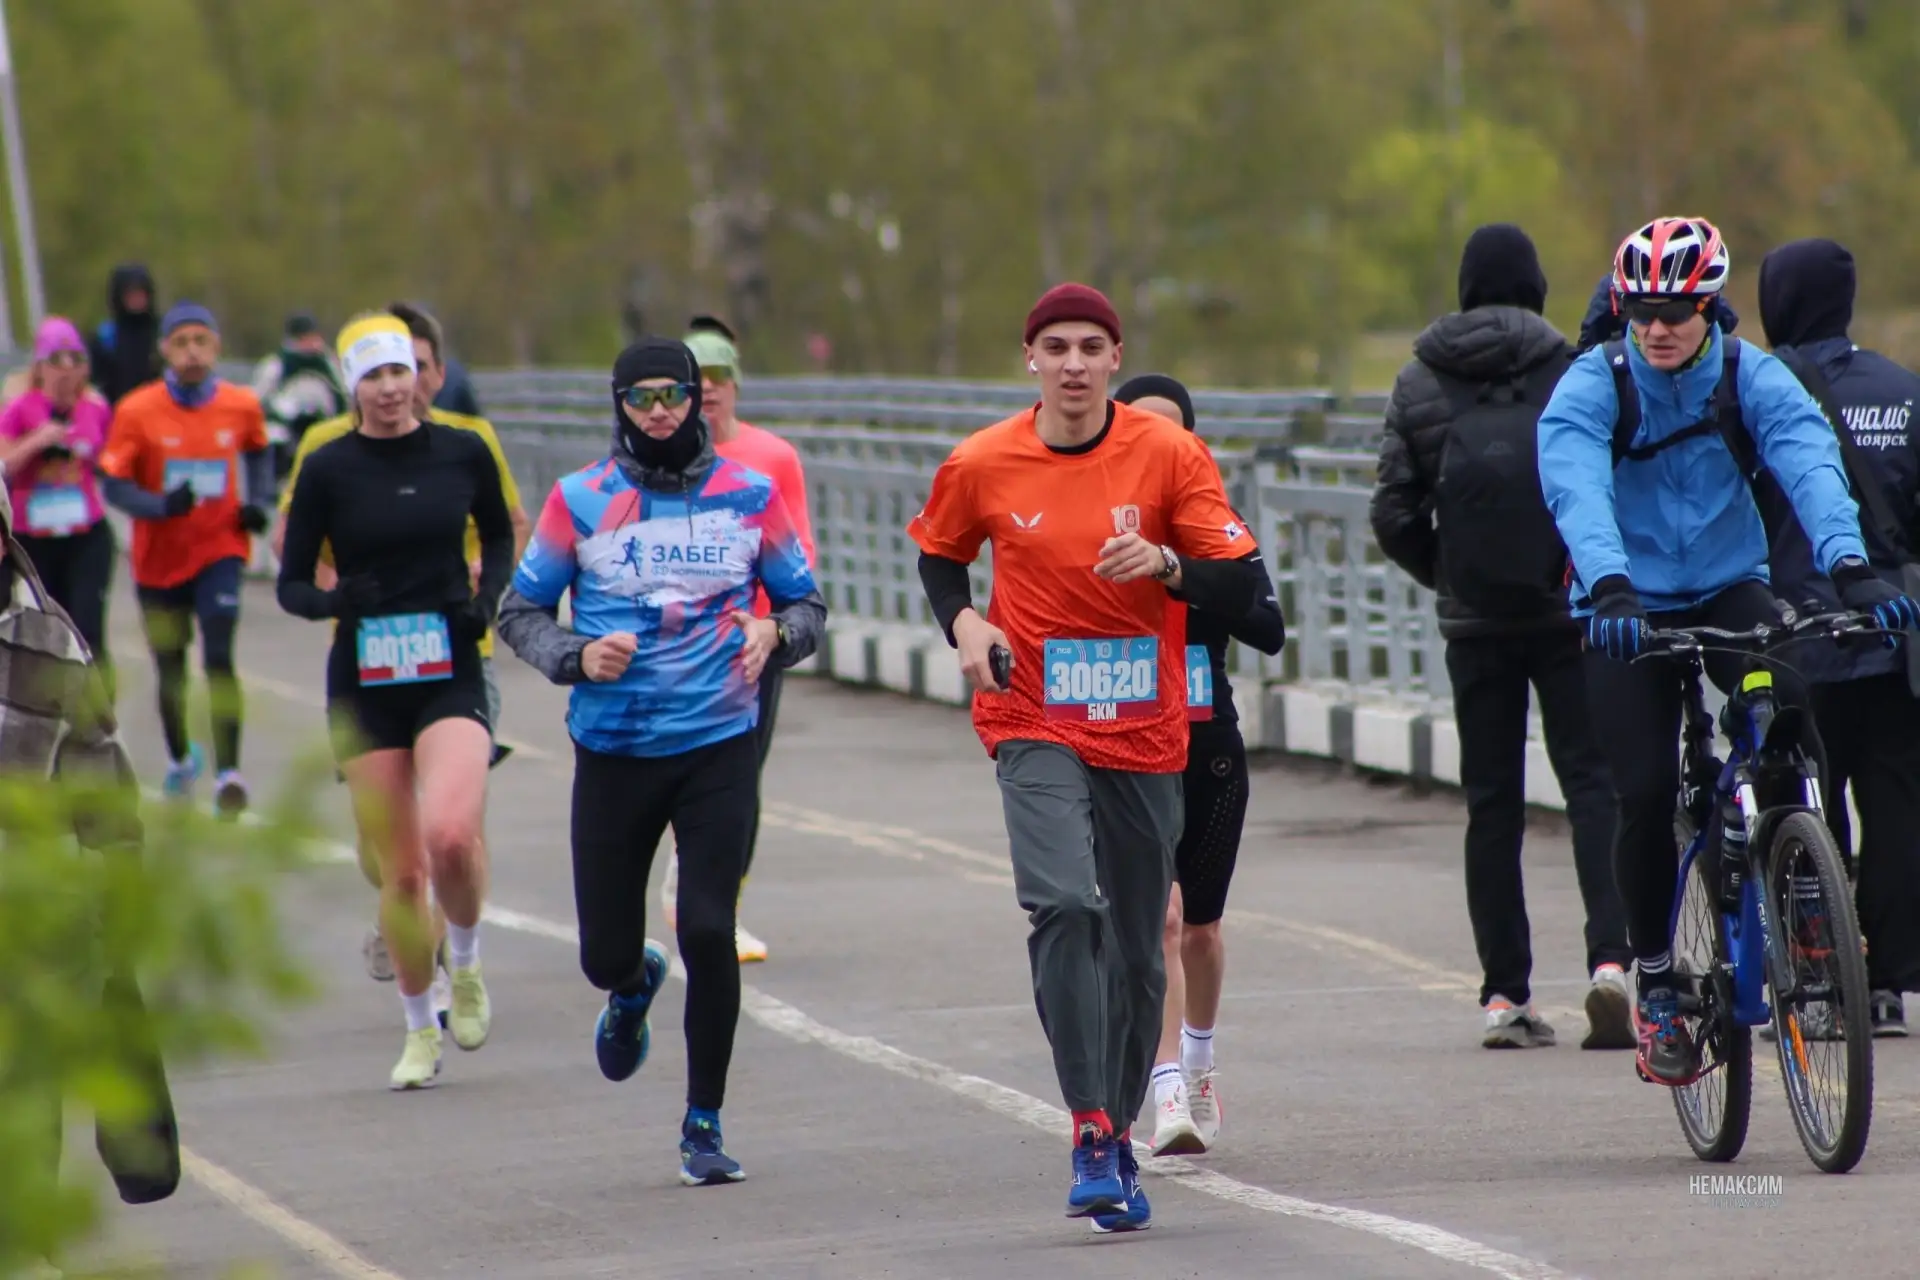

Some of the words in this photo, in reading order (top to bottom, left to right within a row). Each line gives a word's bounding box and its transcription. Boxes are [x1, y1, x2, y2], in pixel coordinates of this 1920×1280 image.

[651, 545, 730, 564] ЗАБЕГ
[1051, 659, 1151, 701] 30620
[1087, 702, 1117, 721] 5KM
